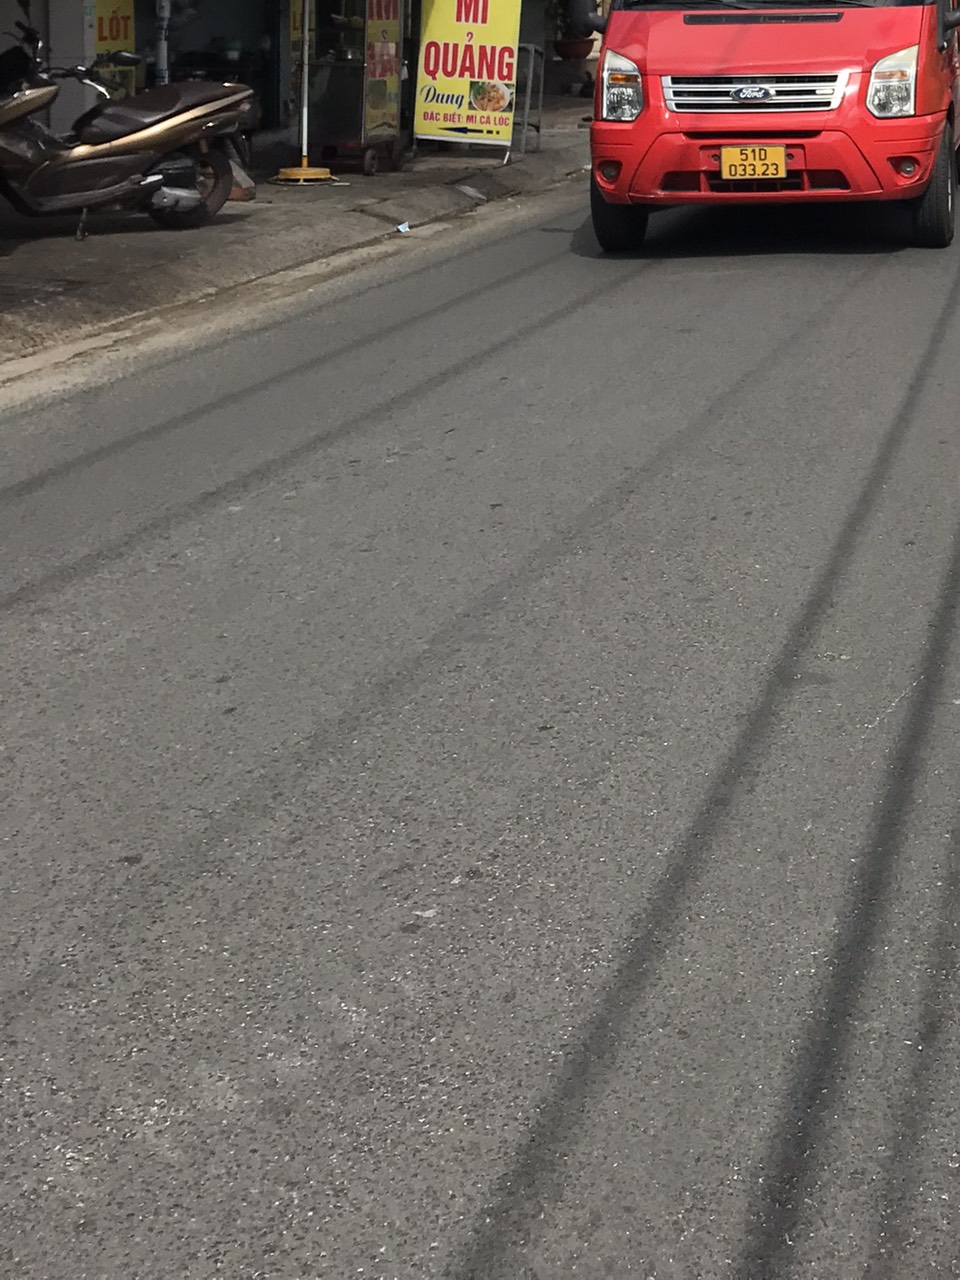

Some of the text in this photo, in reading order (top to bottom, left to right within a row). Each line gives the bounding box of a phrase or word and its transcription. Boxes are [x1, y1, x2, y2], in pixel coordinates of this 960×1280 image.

[98, 7, 131, 42] LỐT
[423, 31, 515, 81] QUẢNG
[420, 84, 464, 110] Dung
[740, 87, 765, 99] Ford
[740, 148, 767, 161] 51D
[729, 163, 779, 177] 033.23
